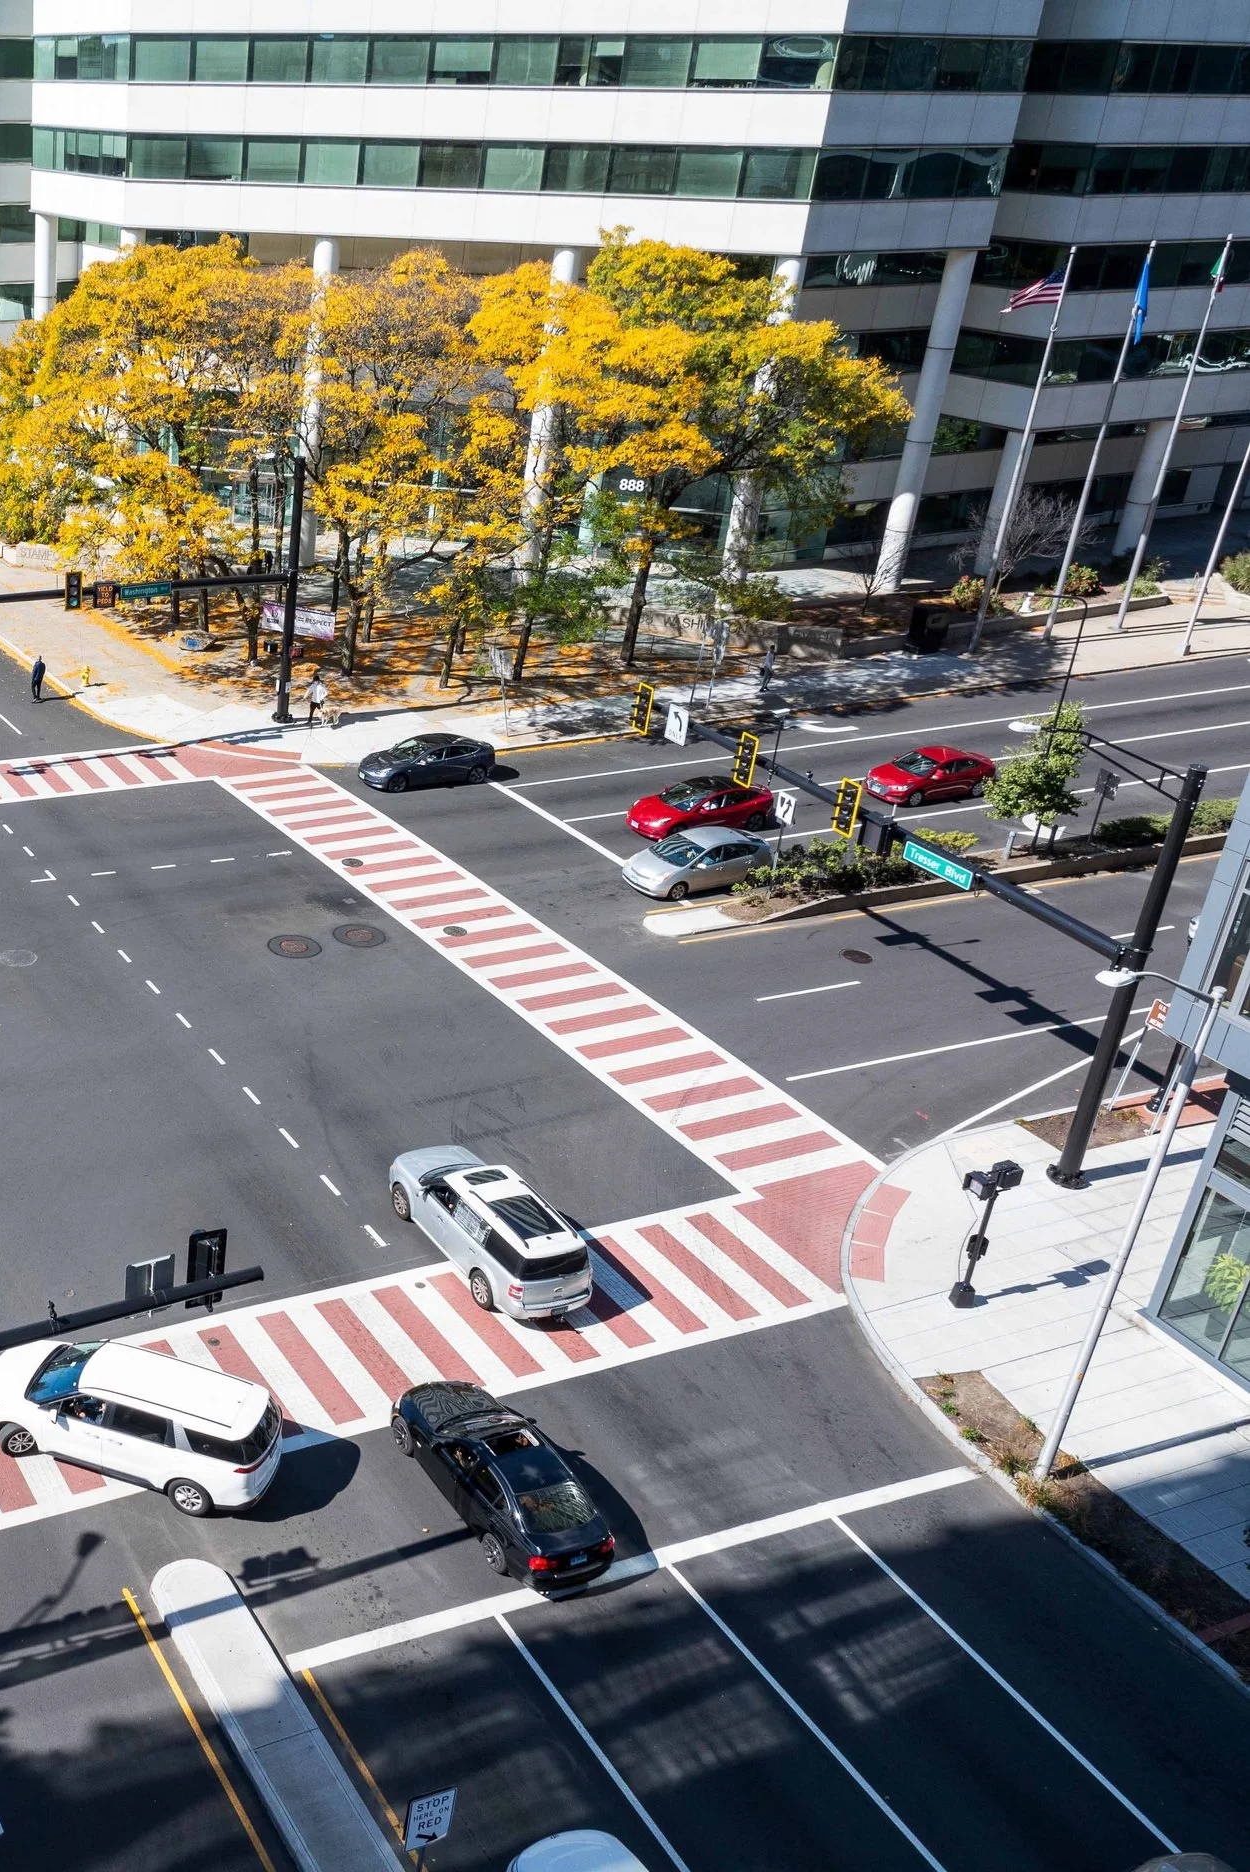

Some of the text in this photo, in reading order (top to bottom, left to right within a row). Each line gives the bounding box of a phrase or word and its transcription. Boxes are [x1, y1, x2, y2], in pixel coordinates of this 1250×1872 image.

[619, 478, 645, 492] 888
[124, 587, 158, 596] Washington
[305, 617, 332, 627] RESPECT
[668, 729, 682, 740] ONLY
[910, 847, 966, 884] Tresser Blvd
[416, 1795, 450, 1813] STOP
[413, 1805, 450, 1822] HERE ON
[417, 1816, 442, 1831] RED
